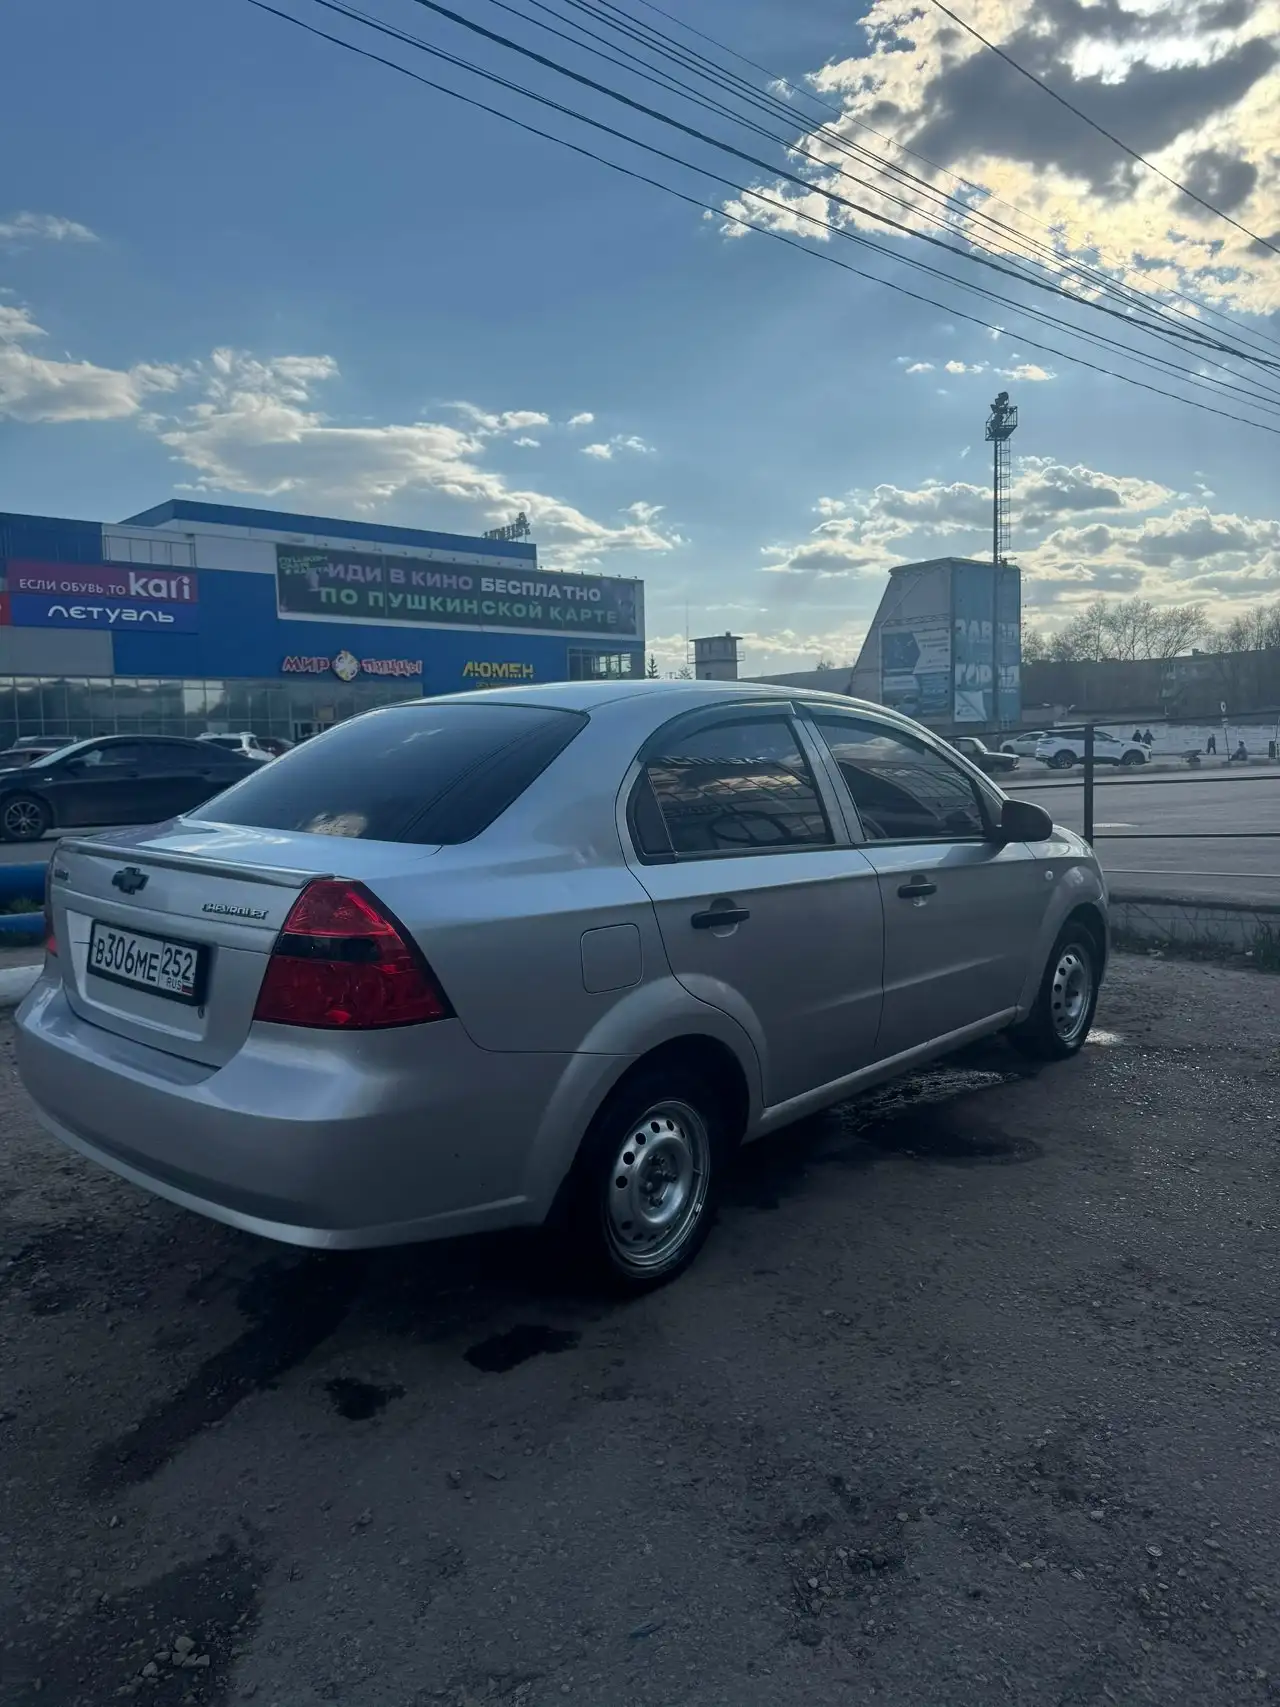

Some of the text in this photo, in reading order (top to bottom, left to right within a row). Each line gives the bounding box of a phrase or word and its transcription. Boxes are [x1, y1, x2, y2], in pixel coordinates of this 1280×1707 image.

[19, 578, 57, 592] ЕСЛИ
[60, 580, 104, 594] ОБУВЬ
[128, 571, 191, 600] kari
[328, 563, 601, 602] ИДИ В КИНО БЕСПЛАТНО
[320, 587, 618, 624] ПО ПУШКИНСКОЙ КАРТЕ
[282, 655, 423, 677] МИР ПИЦЦЫ
[462, 661, 534, 679] ЛЮМЕН
[202, 903, 269, 920] CHEVROLET
[161, 946, 195, 981] 252
[165, 977, 182, 991] RUS
